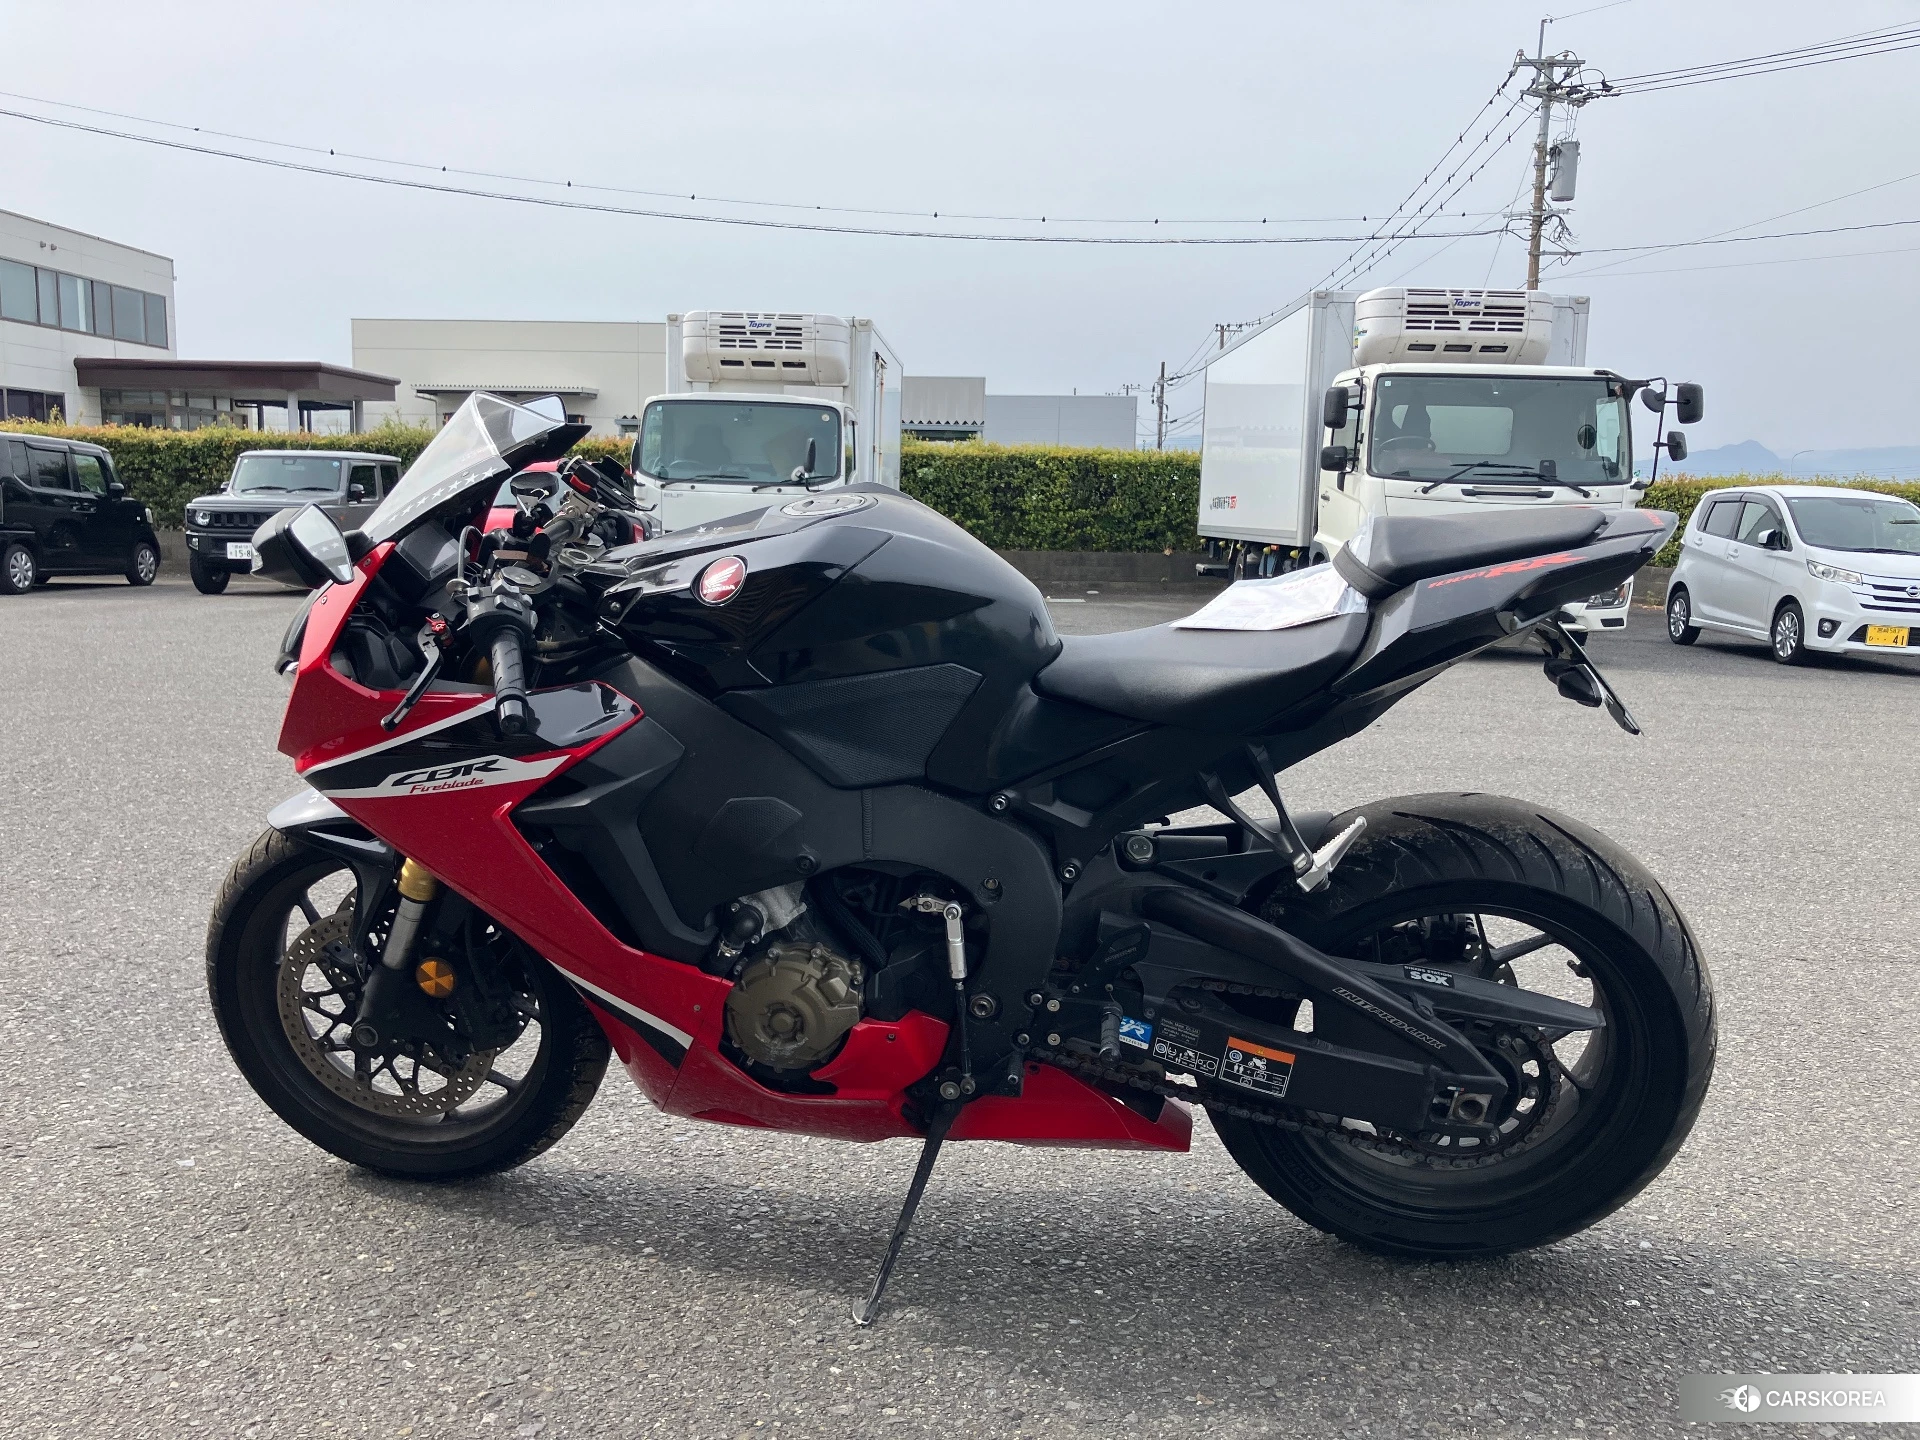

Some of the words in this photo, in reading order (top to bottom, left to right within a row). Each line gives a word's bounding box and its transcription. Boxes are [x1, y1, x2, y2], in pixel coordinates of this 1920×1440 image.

[391, 758, 509, 787] CBR
[409, 777, 484, 795] Fireblade
[1410, 970, 1450, 987] SOX
[1332, 986, 1374, 1010] UNIT
